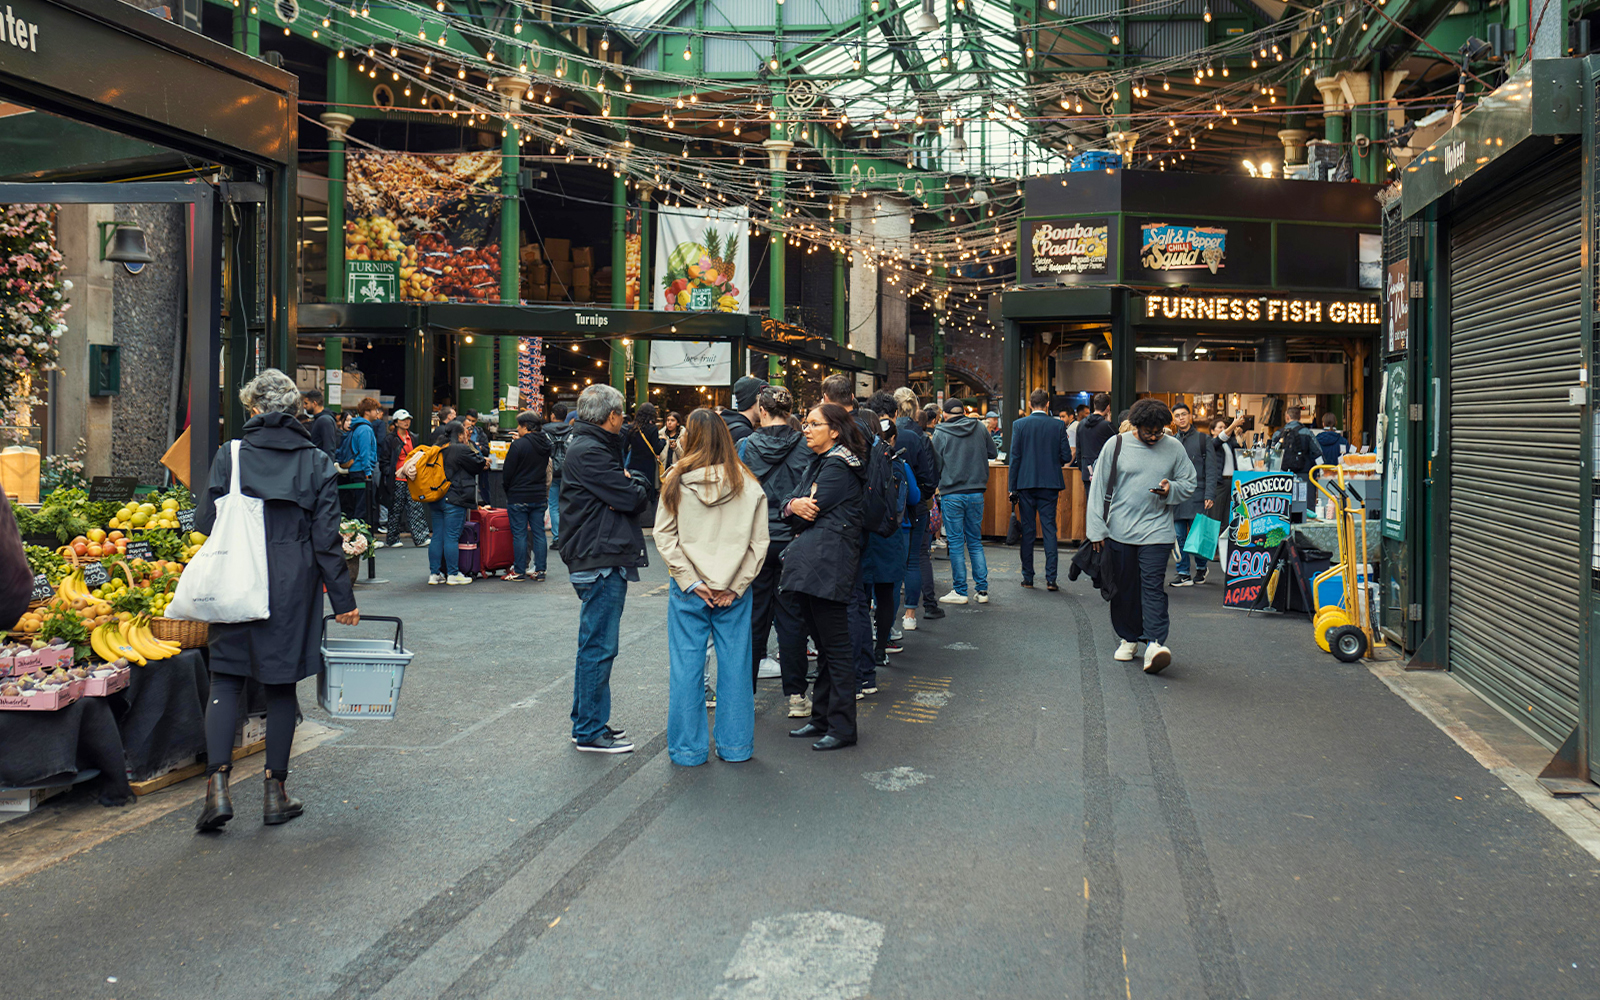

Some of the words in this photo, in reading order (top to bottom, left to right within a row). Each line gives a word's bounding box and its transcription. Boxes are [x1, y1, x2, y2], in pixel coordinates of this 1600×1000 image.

[1041, 223, 1094, 240] Bomba
[1148, 228, 1175, 246] Salt
[1173, 230, 1185, 243] &
[1186, 231, 1223, 250] Pepper
[1040, 240, 1086, 256] Paella
[1168, 243, 1190, 252] CHILLI
[1142, 244, 1200, 271] Squid
[349, 262, 395, 273] TURNIPS
[1146, 296, 1261, 321] FURNESS
[1267, 299, 1322, 322] FISH
[575, 313, 609, 327] Turnips
[1242, 478, 1293, 500] PROSECCO
[1249, 499, 1261, 518] ICE
[1260, 497, 1286, 515] COLD!
[1224, 589, 1232, 604] A
